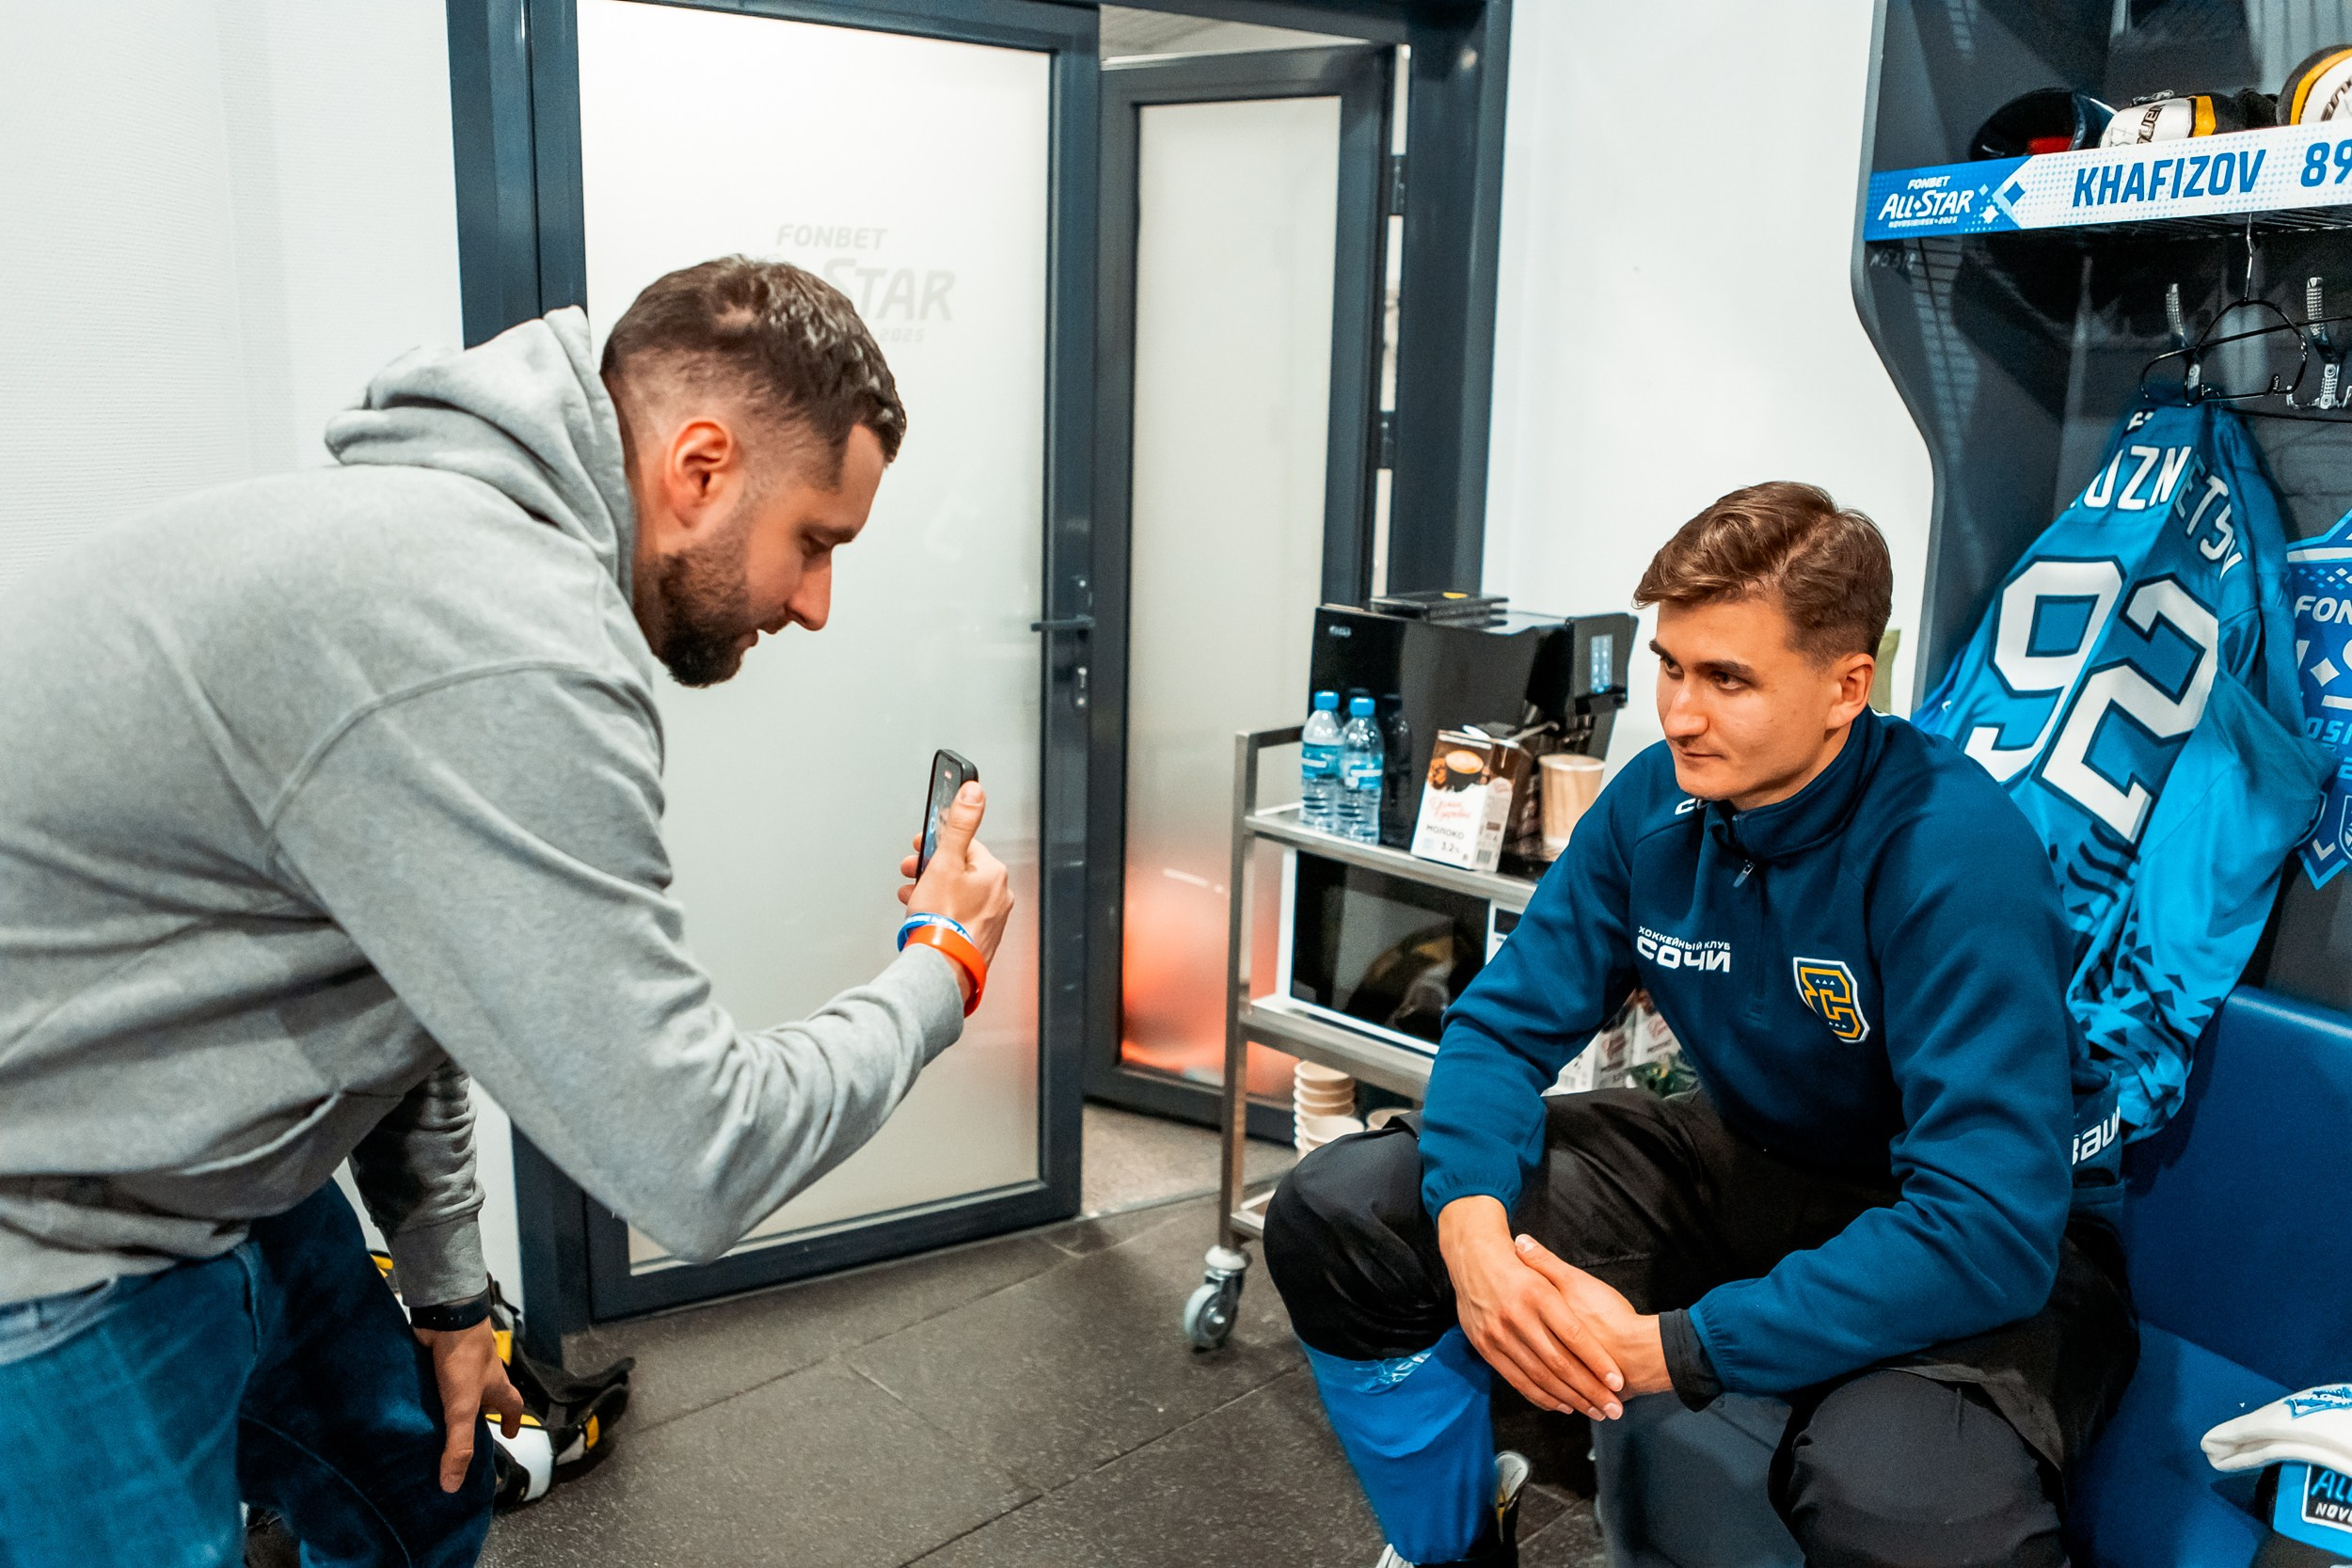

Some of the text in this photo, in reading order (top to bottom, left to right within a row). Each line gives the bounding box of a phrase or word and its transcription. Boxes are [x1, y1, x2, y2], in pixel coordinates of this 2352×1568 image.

[1907, 175, 1951, 190] FONBET
[2073, 138, 2352, 208] KHAFIZOV 89
[775, 224, 888, 250] FONBET
[1963, 560, 2220, 844] 92
[1637, 935, 1731, 973] СОЧИ
[1639, 926, 1731, 951] ХОККЕЙНЫЙ КЛУБ
